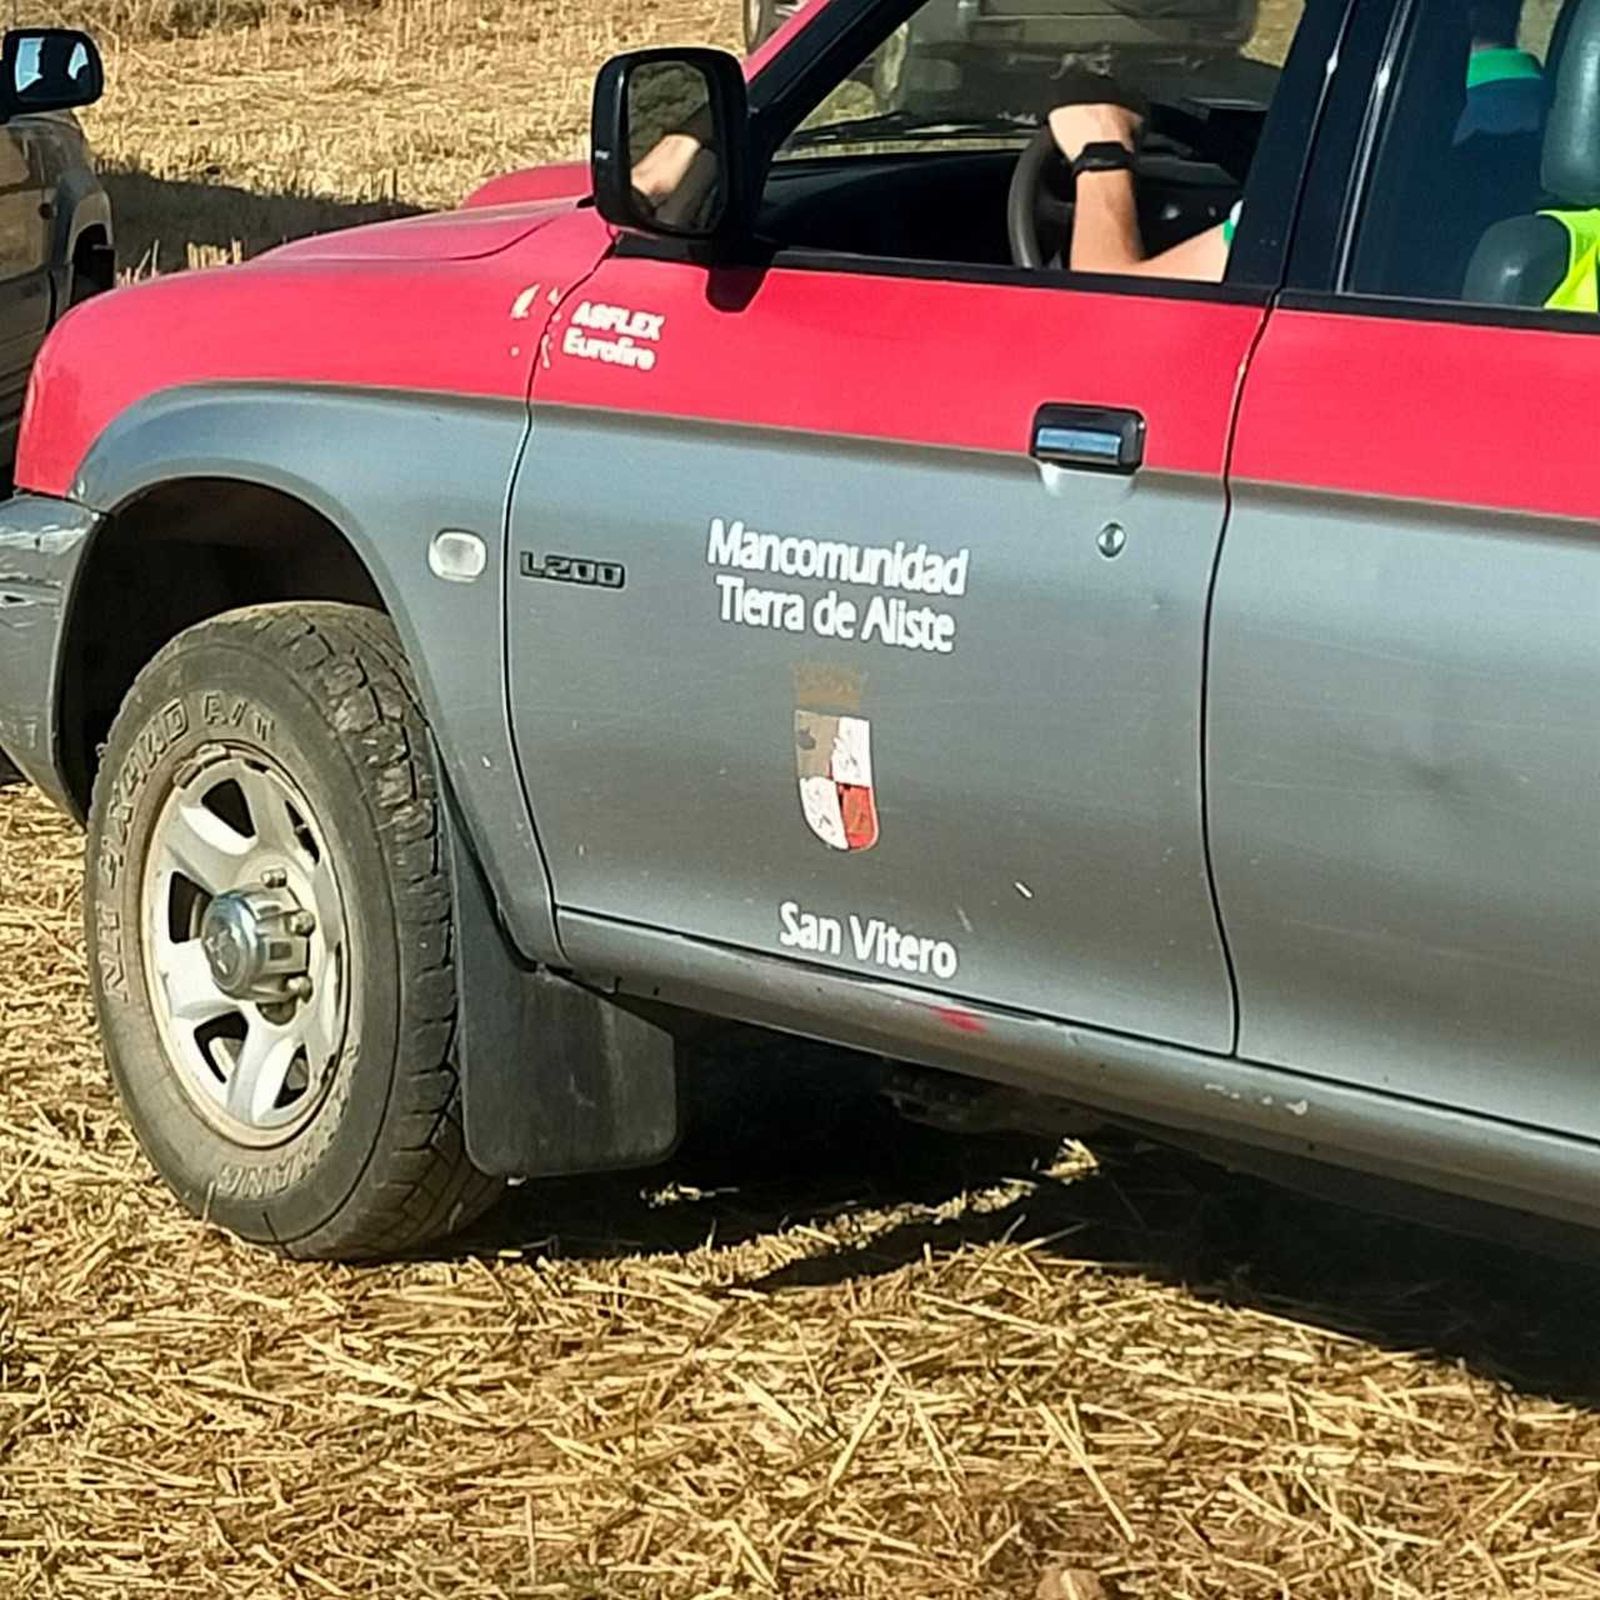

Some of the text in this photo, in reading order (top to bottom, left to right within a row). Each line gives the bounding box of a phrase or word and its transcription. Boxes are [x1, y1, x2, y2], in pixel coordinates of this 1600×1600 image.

[520, 551, 625, 589] L200
[707, 518, 969, 596] Mancomunidad
[715, 574, 956, 653] Tierra de Aliste
[779, 900, 958, 979] San Vitero
